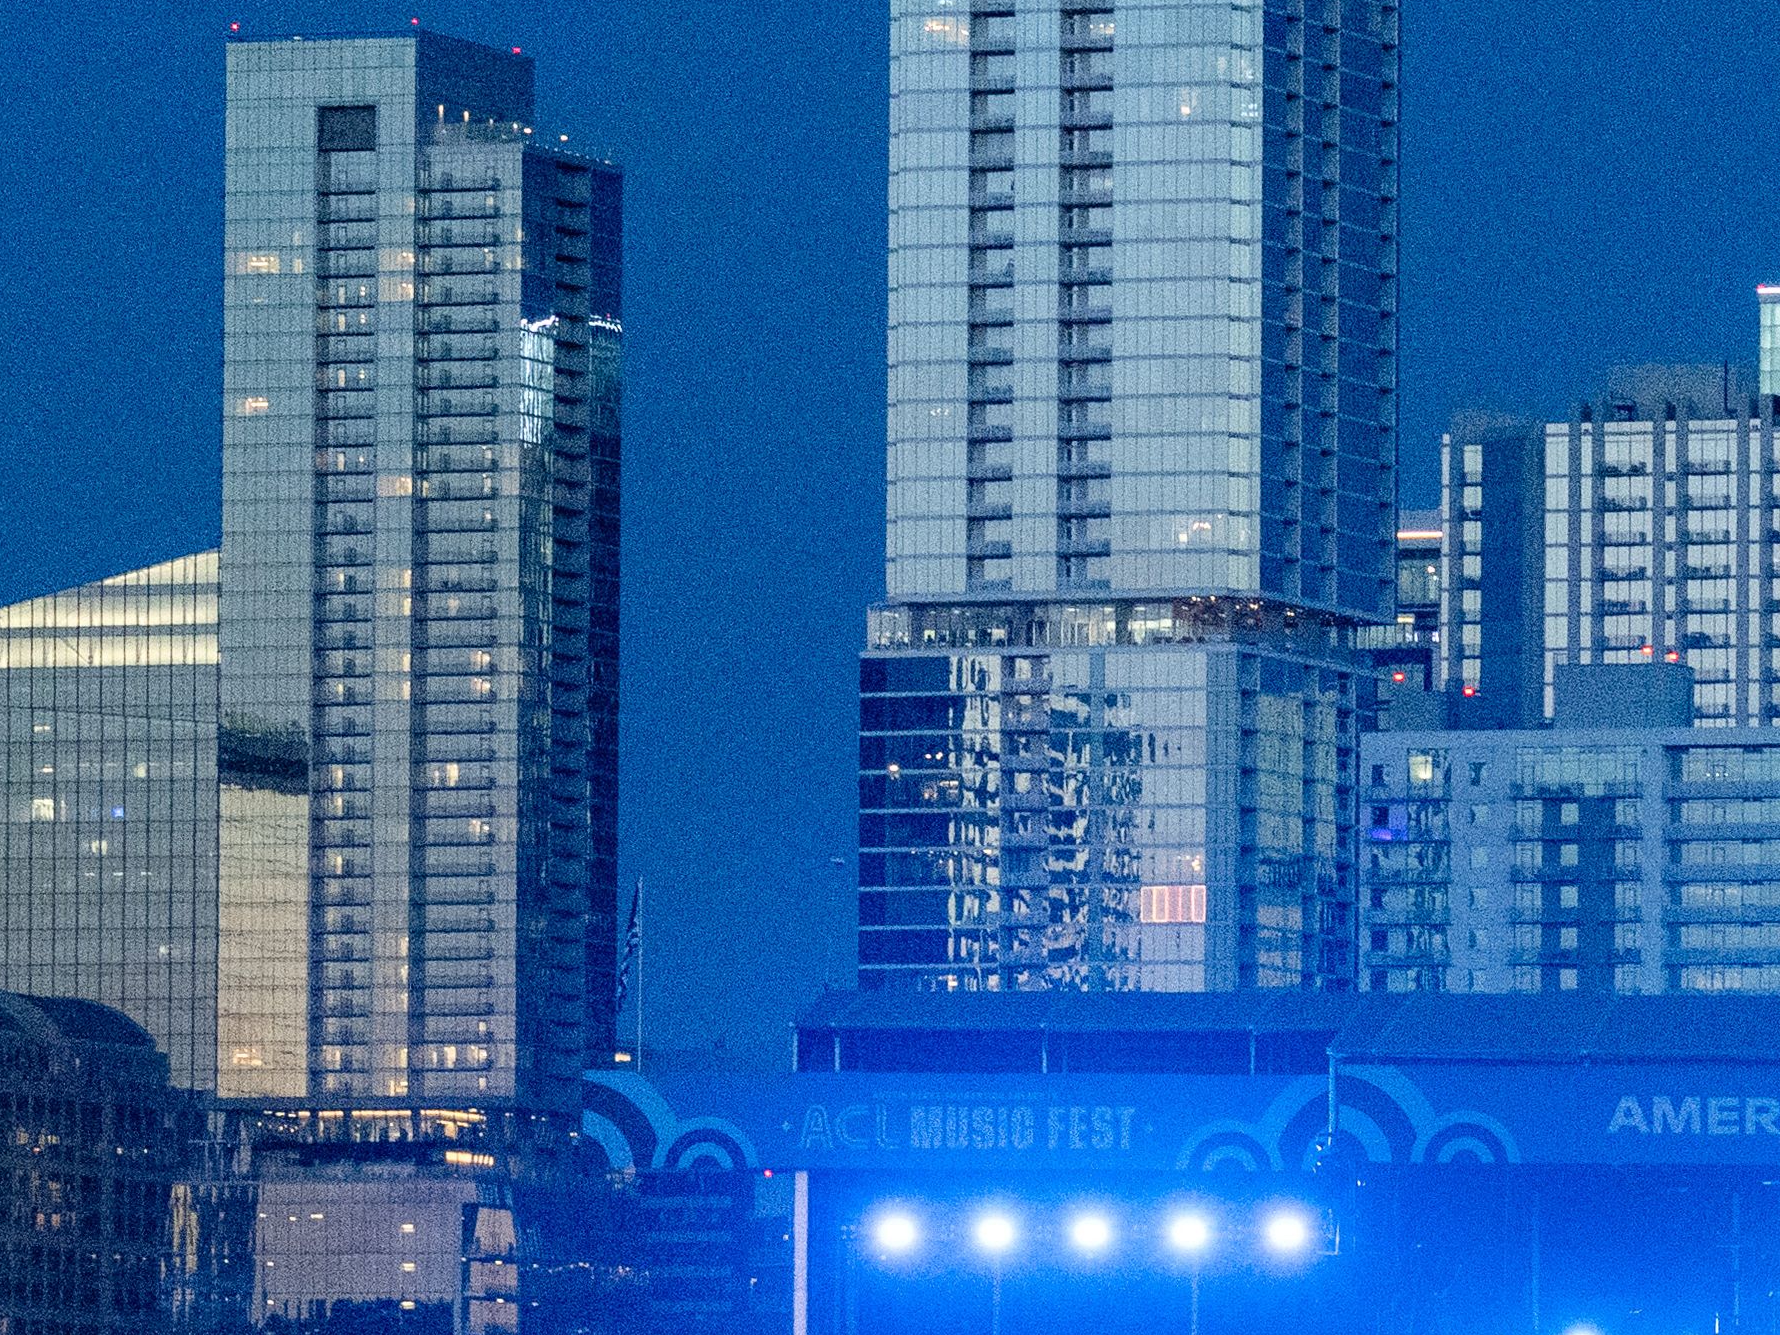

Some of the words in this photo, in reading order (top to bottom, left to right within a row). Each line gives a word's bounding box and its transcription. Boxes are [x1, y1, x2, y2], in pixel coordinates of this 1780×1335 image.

[799, 1104, 901, 1150] ACL
[910, 1106, 1035, 1150] MUSIC
[1047, 1105, 1137, 1150] FEST
